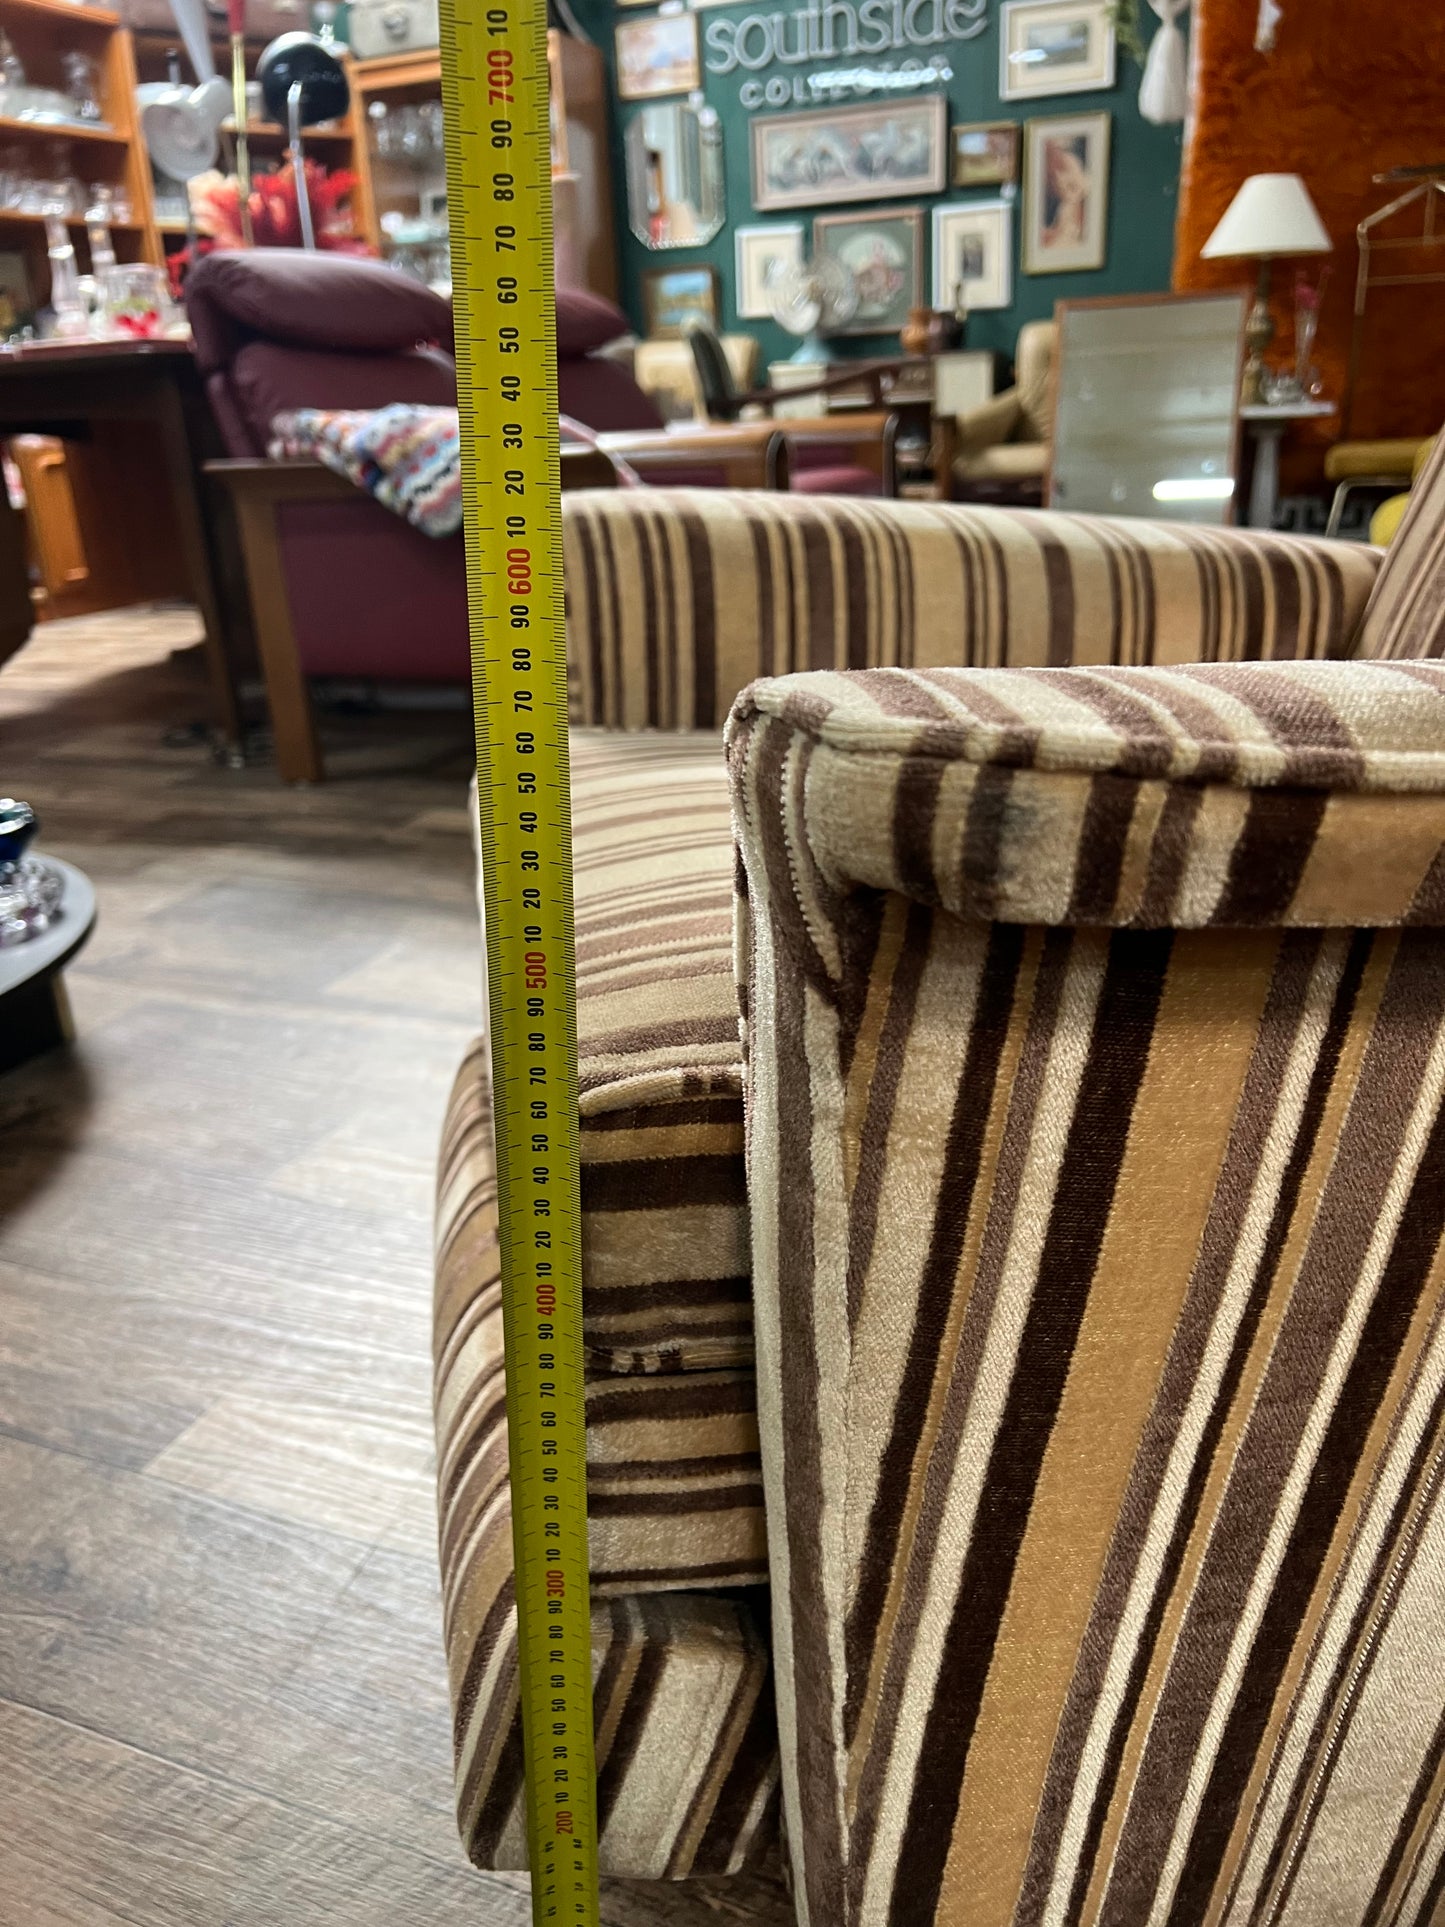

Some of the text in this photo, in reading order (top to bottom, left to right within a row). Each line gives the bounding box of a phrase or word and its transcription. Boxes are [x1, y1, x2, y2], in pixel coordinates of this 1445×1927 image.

[487, 10, 507, 36] 10
[487, 51, 514, 105] 700
[491, 120, 512, 148] 90
[493, 174, 514, 201] 80
[495, 226, 515, 252] 70
[497, 277, 517, 303] 60
[499, 328, 519, 353] 50
[501, 376, 520, 401] 40
[503, 424, 522, 448] 30
[504, 471, 524, 495] 20
[506, 517, 525, 537] 10
[507, 549, 531, 594] 600
[510, 605, 529, 628] 90
[512, 649, 531, 671] 80
[514, 691, 532, 712] 70
[516, 732, 534, 754] 60
[518, 773, 536, 793] 50
[519, 812, 537, 833] 40
[521, 851, 539, 871] 30
[522, 889, 540, 909] 20
[524, 926, 541, 943] 10
[525, 952, 547, 989] 500
[527, 998, 544, 1016] 90
[528, 1033, 545, 1051] 80
[529, 1067, 546, 1085] 70
[530, 1101, 547, 1119] 60
[532, 1134, 548, 1151] 50
[533, 1167, 549, 1184] 40
[534, 1199, 550, 1216] 30
[535, 1231, 551, 1248] 20
[536, 1263, 552, 1277] 10
[536, 1285, 556, 1316] 400
[537, 1324, 553, 1339] 90
[539, 1354, 554, 1369] 80
[540, 1383, 555, 1398] 70
[541, 1412, 556, 1427] 60
[542, 1440, 557, 1455] 50
[543, 1468, 558, 1482] 40
[544, 1496, 559, 1510] 30
[545, 1523, 560, 1537] 20
[546, 1549, 560, 1561] 10
[546, 1570, 565, 1597] 300
[548, 1600, 562, 1615] 90
[549, 1626, 563, 1639] 80
[550, 1650, 564, 1662] 70
[551, 1675, 565, 1688] 60
[551, 1699, 566, 1712] 50
[552, 1723, 566, 1735] 40
[553, 1746, 567, 1759] 30
[554, 1770, 568, 1782] 20
[555, 1792, 568, 1803] 10
[556, 1811, 573, 1835] 200
